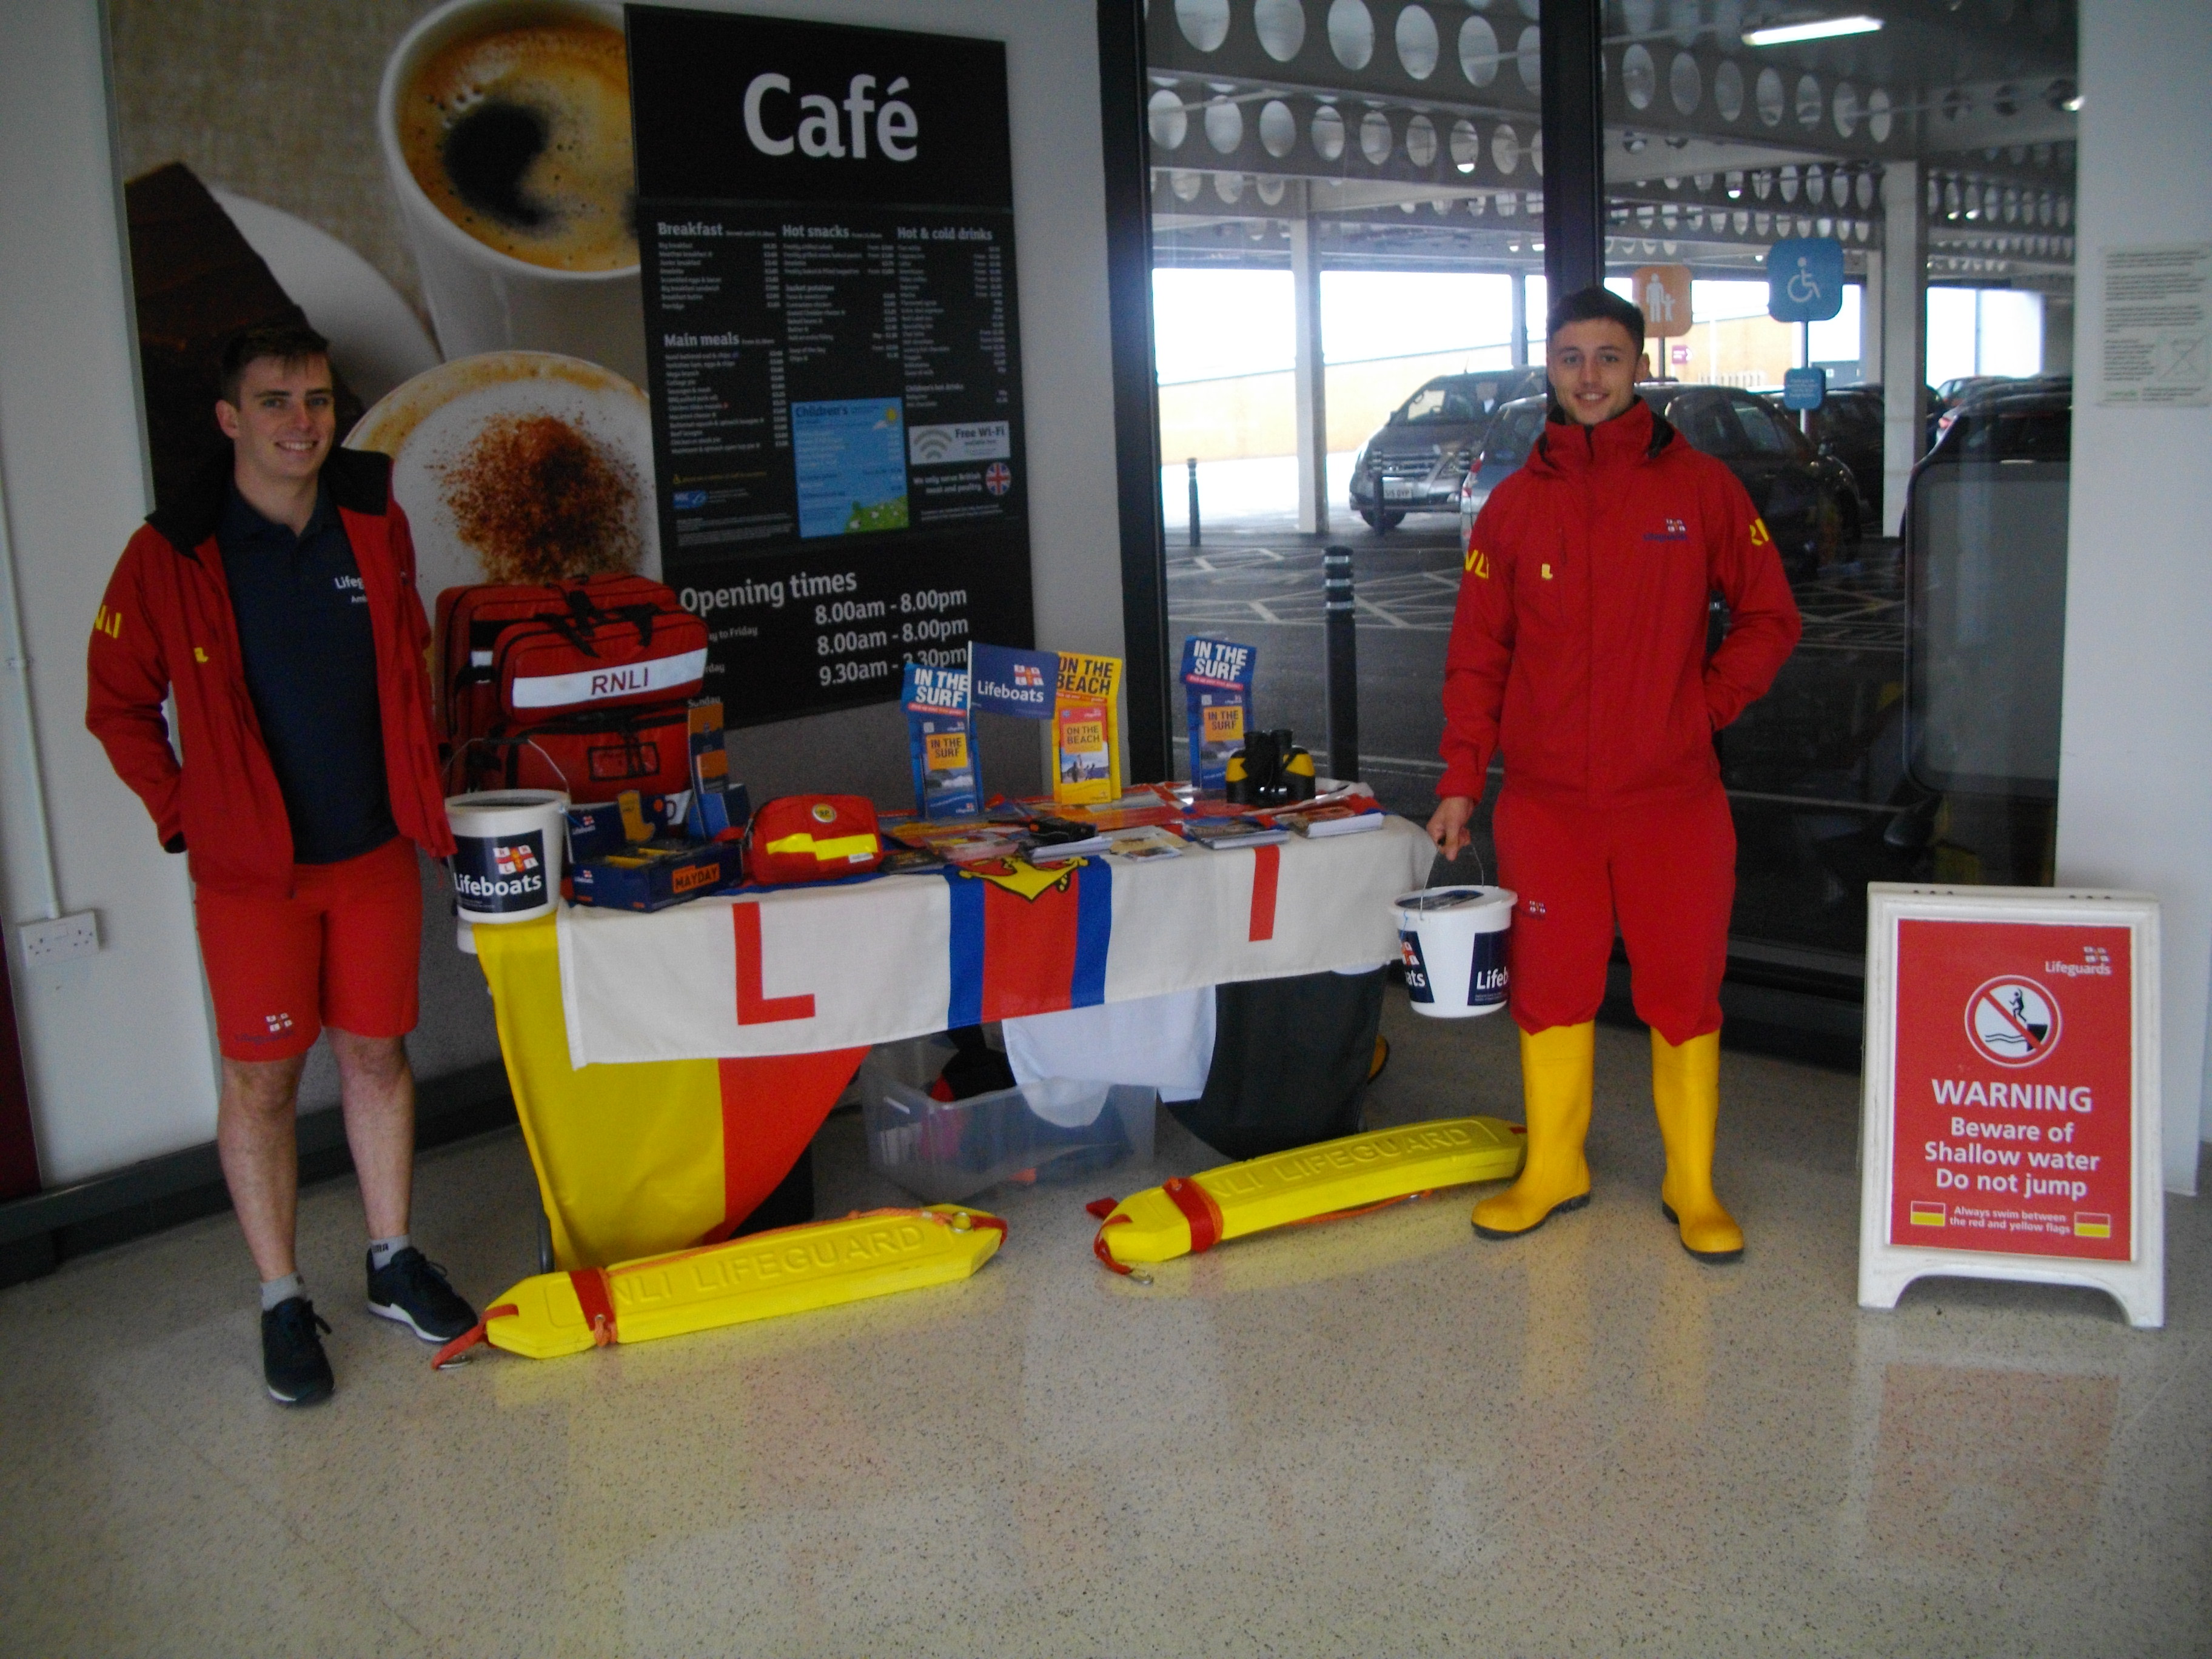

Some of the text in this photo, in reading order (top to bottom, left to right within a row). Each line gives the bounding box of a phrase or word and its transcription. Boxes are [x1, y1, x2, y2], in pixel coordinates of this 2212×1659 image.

[743, 72, 919, 162] Café
[657, 221, 723, 236] Breakfast
[782, 224, 804, 237] Hot
[808, 225, 850, 238] snacks
[897, 226, 920, 240] Hot
[923, 227, 930, 240] &
[932, 227, 955, 240] cold
[958, 227, 993, 241] drinks
[664, 334, 698, 347] Main
[701, 332, 740, 346] meals
[796, 405, 848, 417] Children's
[955, 426, 1005, 438] Free Wi-Fi
[680, 571, 858, 617] Opening times
[815, 599, 885, 626] 8.00am
[900, 588, 968, 614] 8.00pm
[719, 630, 729, 639] to
[730, 626, 758, 638] Friday
[817, 630, 887, 656] 8.00am
[902, 618, 969, 645] 8.00pm
[1193, 639, 1248, 666] IN THE
[705, 662, 725, 674] rday
[819, 660, 888, 686] 9.30am
[1085, 659, 1114, 678] THE
[1195, 658, 1242, 682] SURF
[591, 666, 649, 696] RNLI
[914, 668, 969, 692] IN THE
[1056, 674, 1111, 695] BEACH
[916, 686, 964, 708] SURF
[977, 680, 1044, 703] Lifeboats
[1208, 710, 1239, 720] IN THE
[1212, 720, 1237, 731] SURF
[1067, 725, 1099, 736] ON THE
[1067, 734, 1101, 745] BEACH
[931, 737, 962, 748] IN THE
[936, 748, 960, 758] SURF
[454, 871, 541, 897] Lifeboats
[674, 867, 719, 889] MAYDAY
[733, 902, 816, 1026] L
[2045, 960, 2112, 977] Lifeguards
[1404, 969, 1426, 987] ats
[1931, 1078, 2093, 1113] WARNING
[1951, 1116, 2075, 1143] Beware of
[1273, 1127, 1472, 1182] LIFEGUARD
[1925, 1141, 2100, 1171] Shallow water
[1936, 1168, 2088, 1201] Do not jump
[1954, 1205, 2066, 1222] Always swim between
[1950, 1216, 2071, 1236] the red and yellow flags
[691, 1225, 925, 1293] LIFEGUARD
